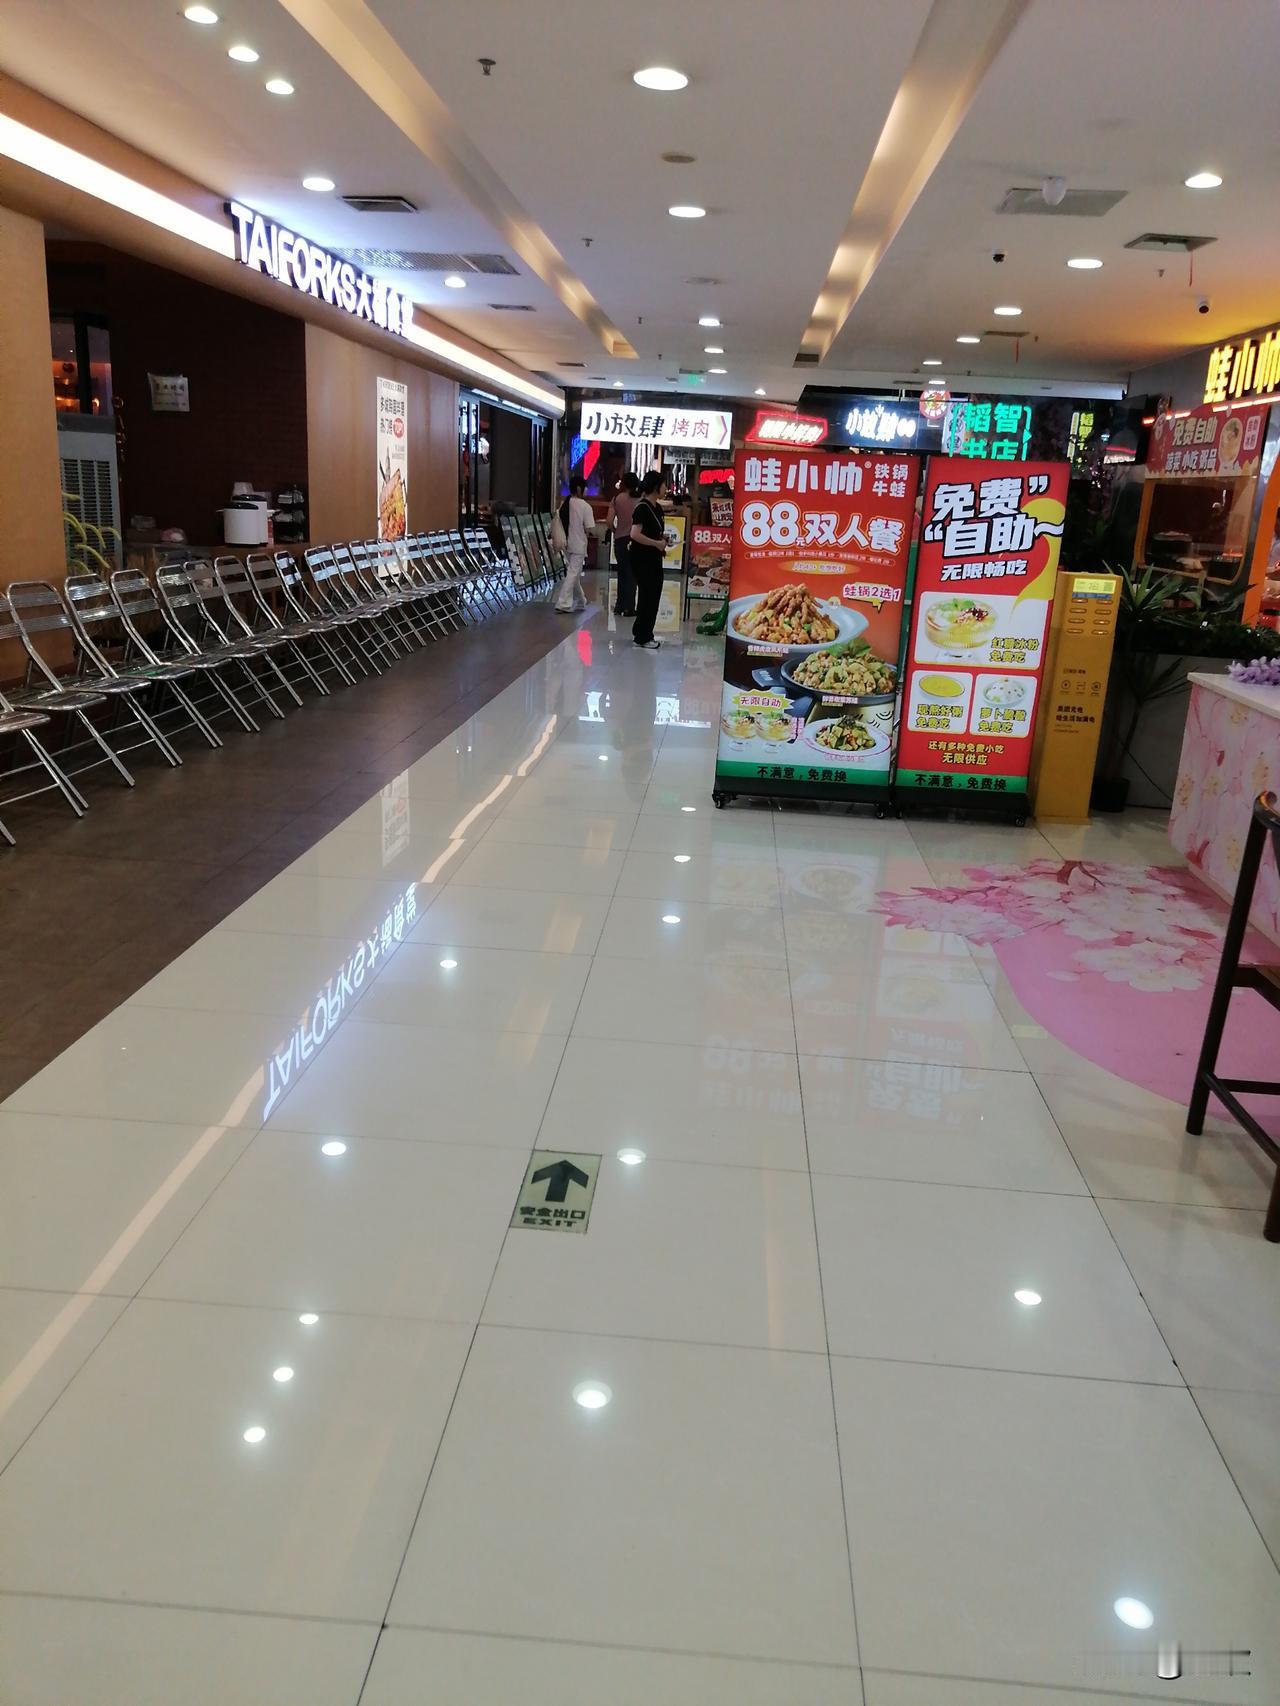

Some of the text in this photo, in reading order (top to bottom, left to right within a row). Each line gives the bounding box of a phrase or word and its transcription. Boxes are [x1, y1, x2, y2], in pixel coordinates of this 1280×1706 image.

[586, 412, 710, 439] 小放肆 烤肉
[1172, 416, 1218, 446] 免费自助
[744, 457, 863, 496] 蛙小帅
[874, 463, 909, 481] 铁锅
[872, 480, 907, 498] 牛蛙
[940, 559, 1028, 582] 无限畅吃
[844, 585, 901, 600] 蛙锅2选1
[991, 636, 1040, 651] 红糖冰粉
[989, 650, 1027, 663] 免费吃
[740, 695, 782, 708] 无限自助
[915, 716, 951, 730] 免费吃
[977, 720, 1014, 734] 免费吃
[928, 740, 1005, 754] 还有多种免费小吃
[942, 752, 988, 766] 无限供应
[520, 1206, 586, 1219] 安全出口
[523, 1217, 577, 1227] EXIT
